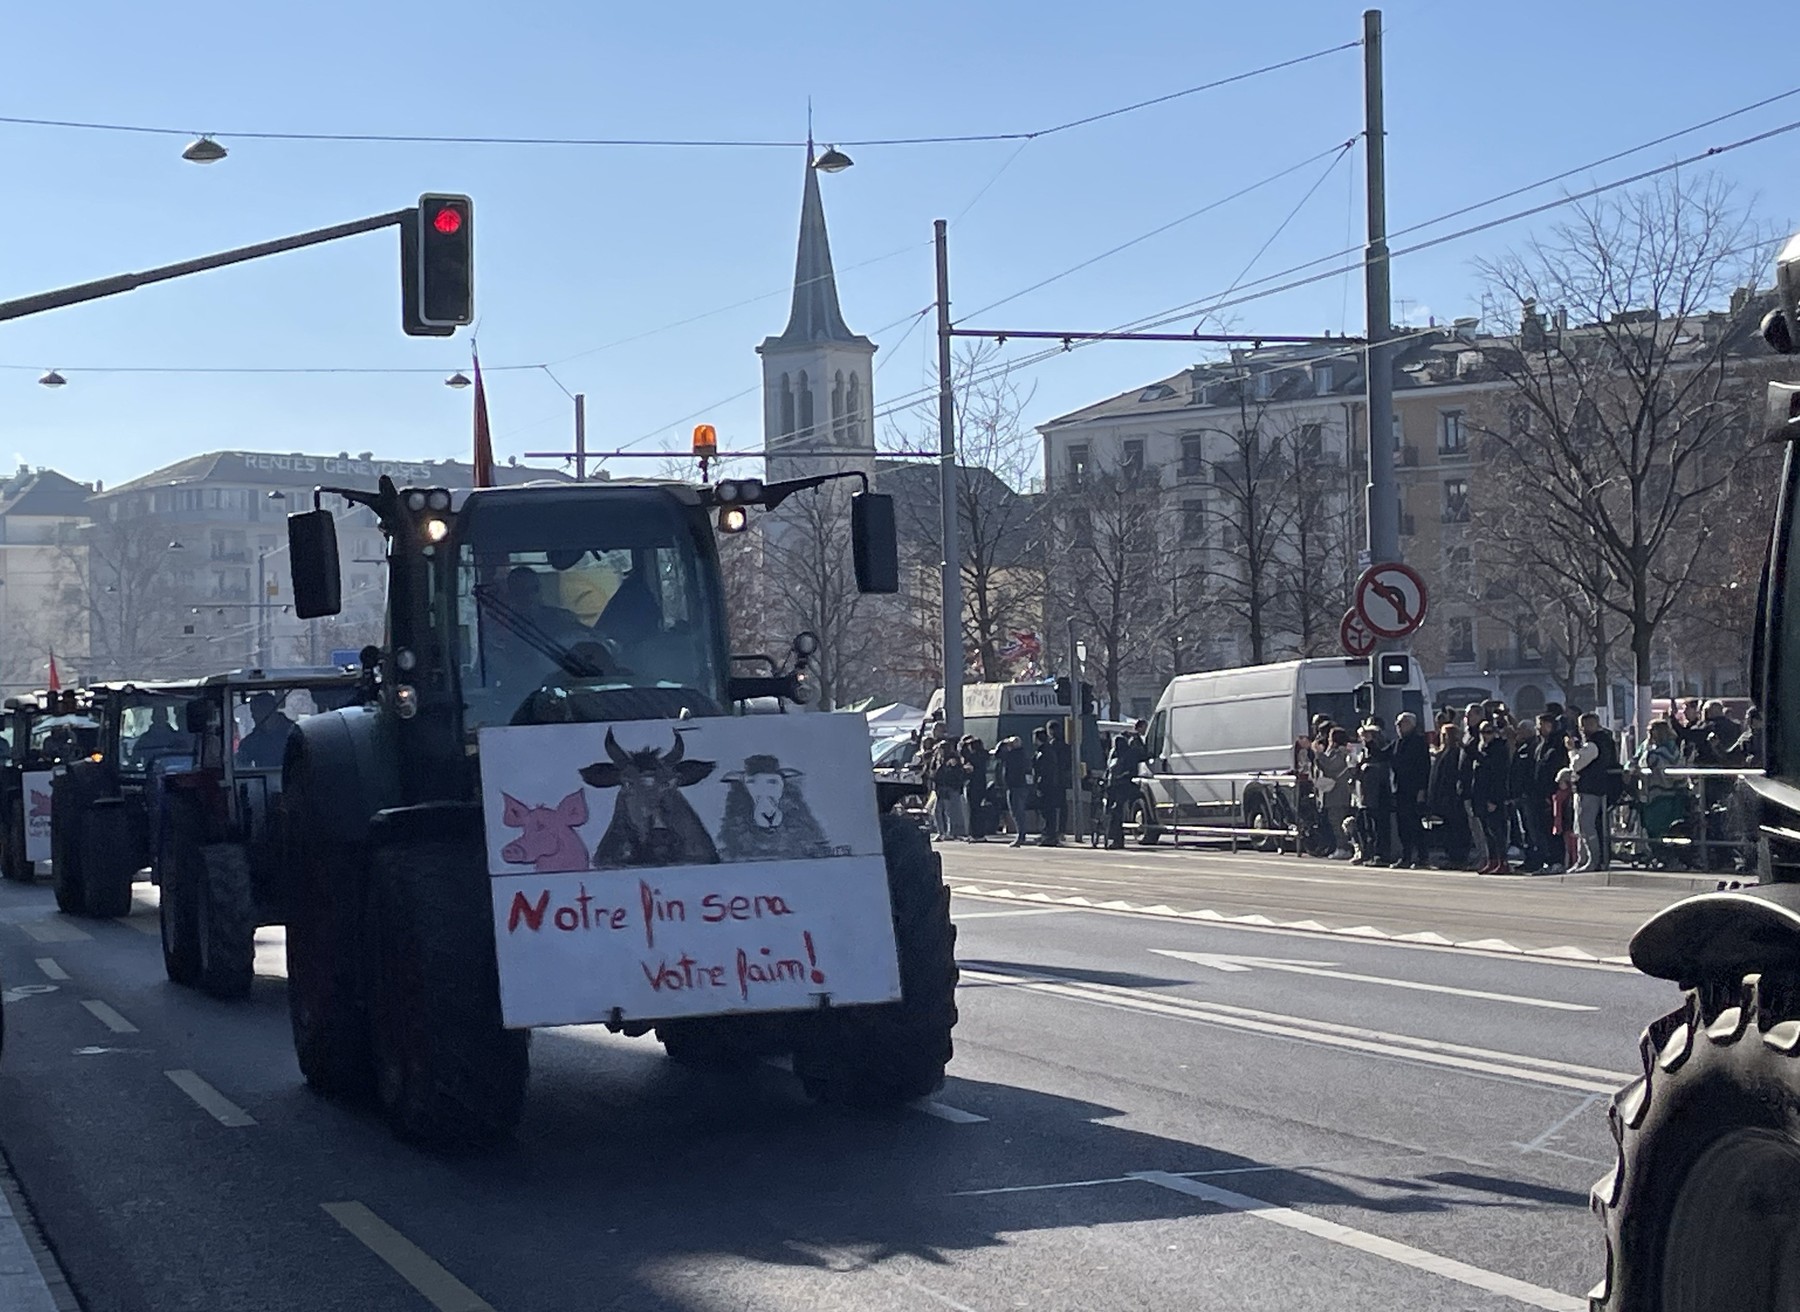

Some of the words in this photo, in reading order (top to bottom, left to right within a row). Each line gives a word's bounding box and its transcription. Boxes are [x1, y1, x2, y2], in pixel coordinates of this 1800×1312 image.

[245, 454, 316, 473] RENTES
[508, 881, 628, 934] Notre
[639, 878, 685, 949] fin
[702, 894, 795, 922] sera
